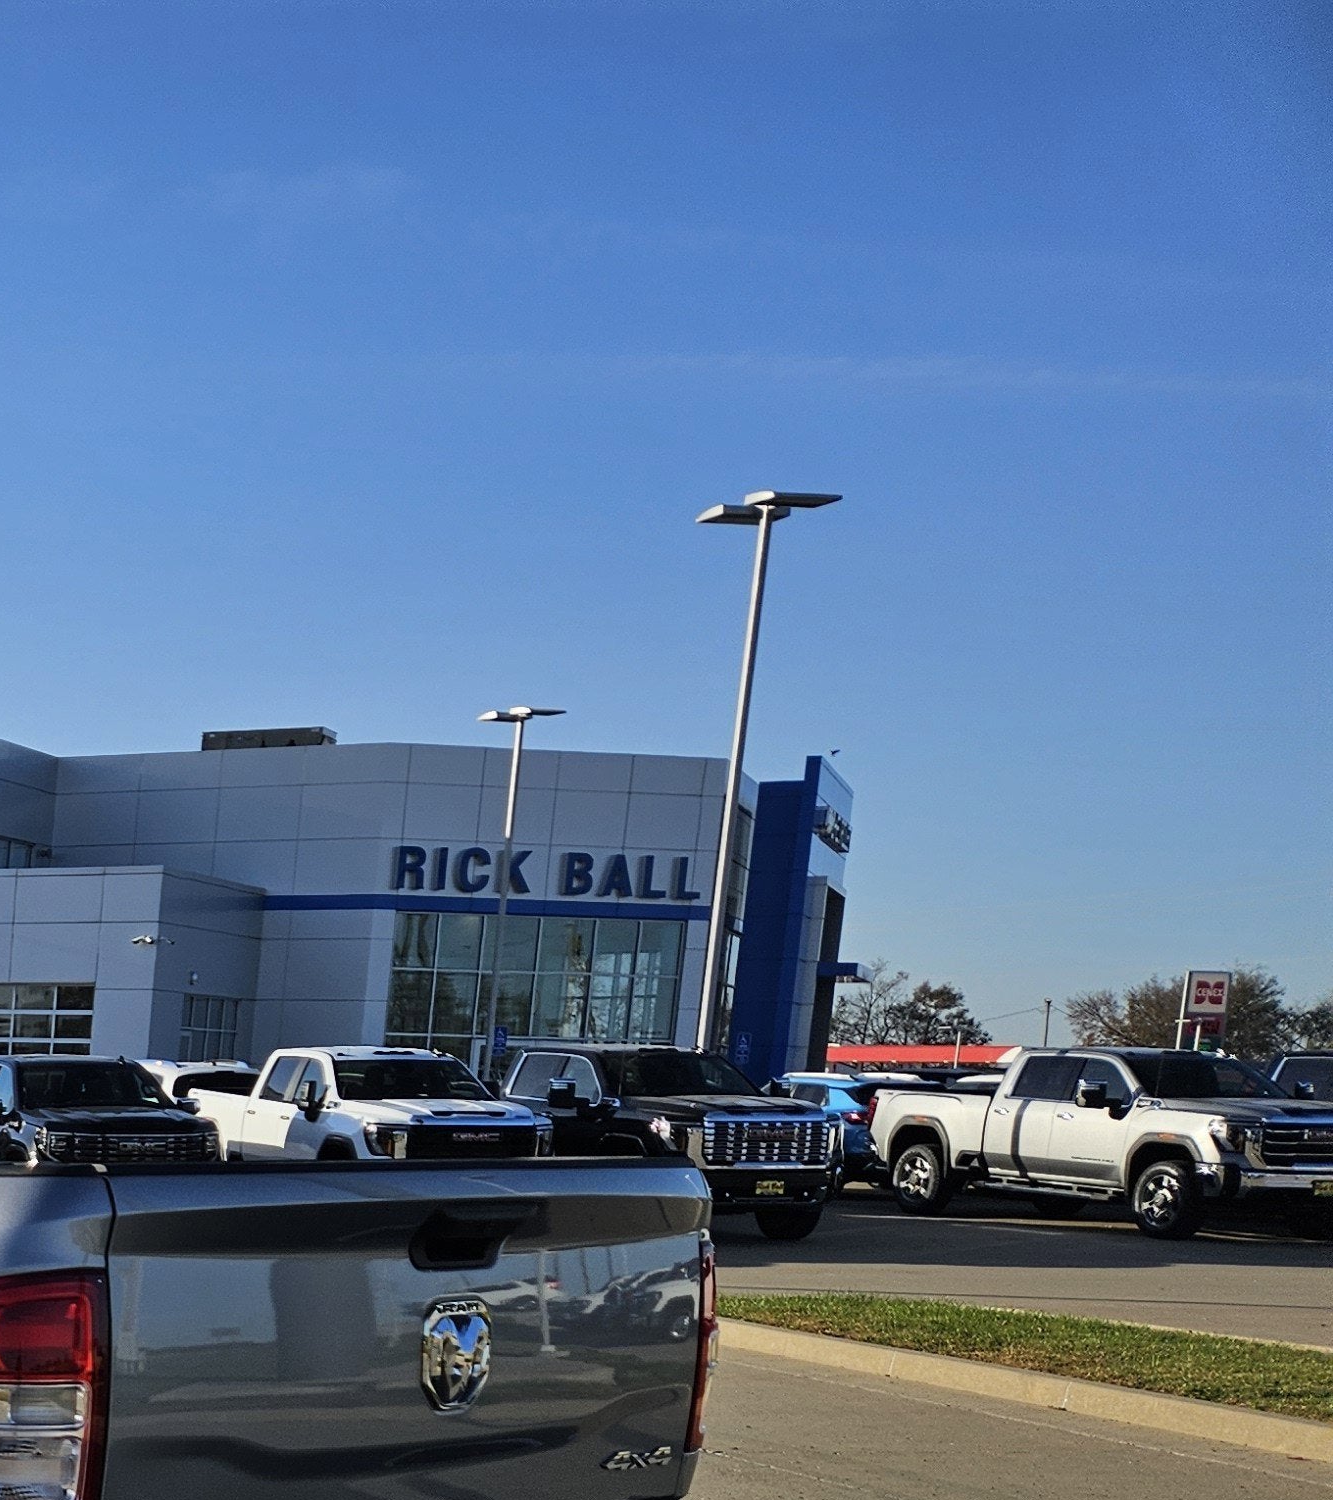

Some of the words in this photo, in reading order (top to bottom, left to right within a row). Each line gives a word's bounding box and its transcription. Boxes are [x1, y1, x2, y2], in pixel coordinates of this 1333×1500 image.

[391, 845, 533, 893] RICK
[558, 852, 701, 900] BALL
[439, 1302, 480, 1315] RAM
